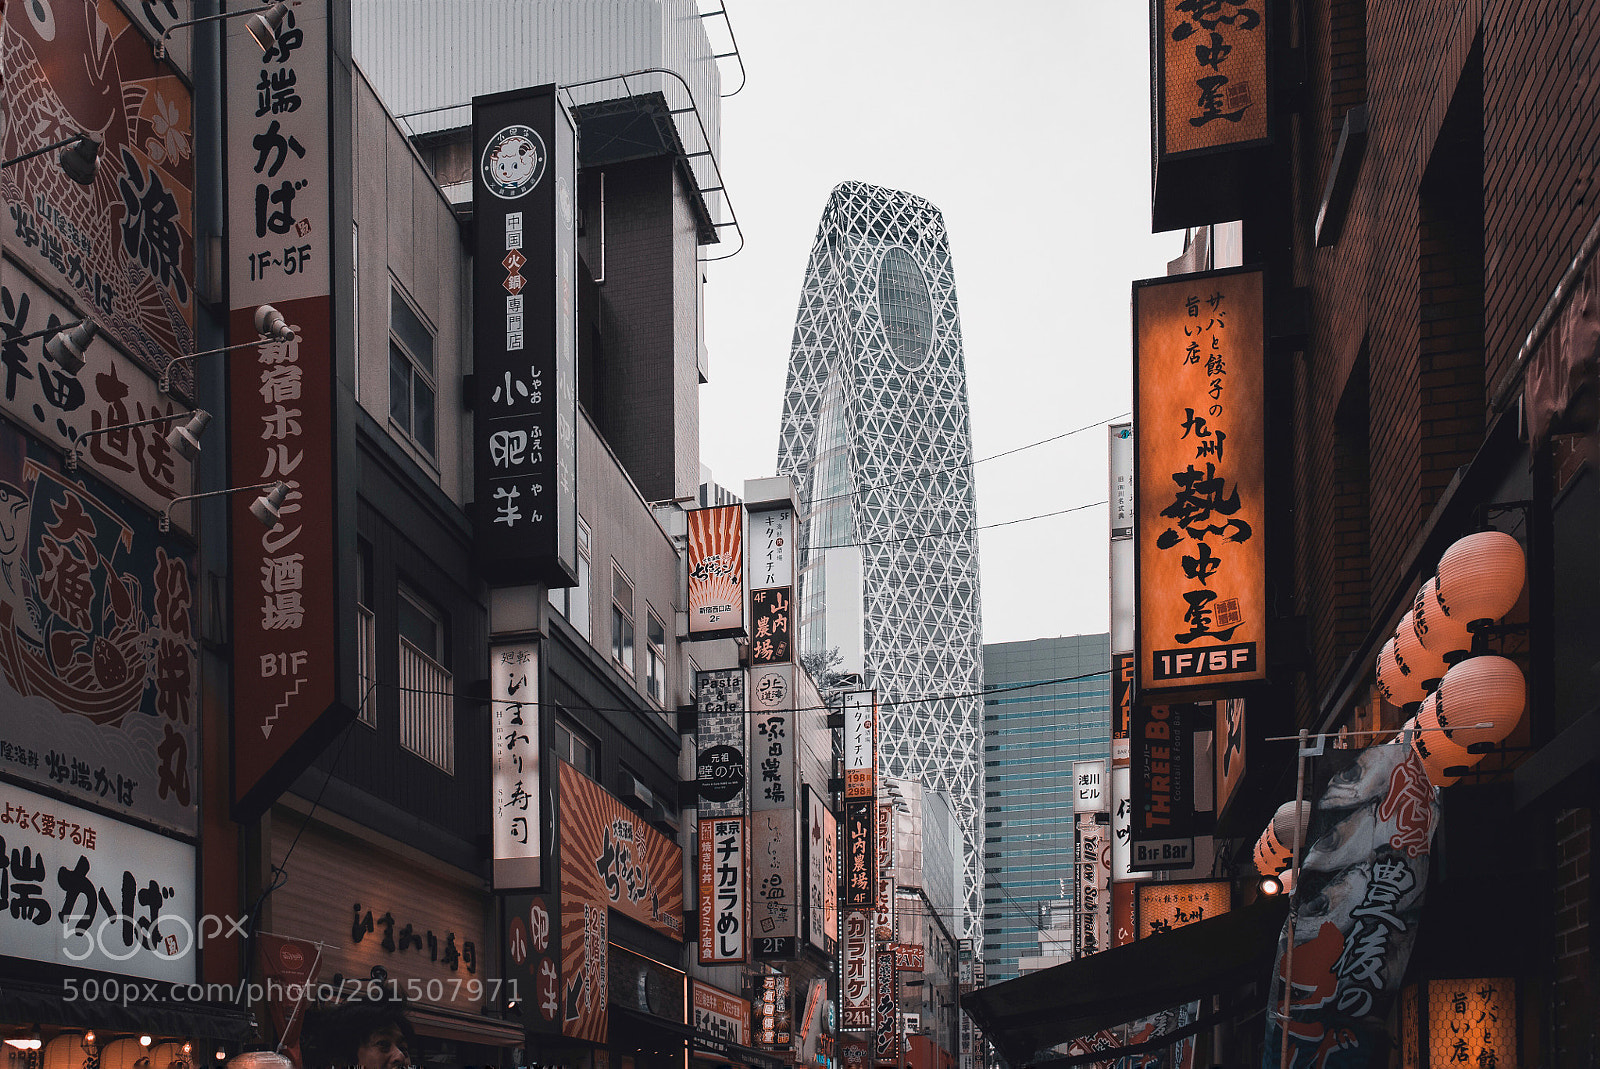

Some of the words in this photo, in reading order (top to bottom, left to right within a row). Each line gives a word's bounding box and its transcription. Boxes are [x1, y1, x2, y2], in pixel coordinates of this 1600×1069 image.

[10, 203, 120, 316] 炉端かば
[507, 213, 523, 350] 中国火鍋専門店
[1183, 295, 1202, 366] 旨い店
[1204, 291, 1227, 418] サバと餃子の
[530, 365, 542, 404] しゃお
[488, 370, 529, 527] 小肥羊
[530, 425, 543, 464] ふぇい
[1180, 407, 1227, 463] 九州
[256, 324, 305, 630] 新宿ホルモン酒場
[530, 483, 543, 522] やん
[780, 512, 790, 521] 5F
[765, 516, 775, 584] キタノイチバ
[1157, 462, 1252, 644] 熱中屋
[754, 592, 767, 602] 4F
[771, 592, 788, 633] 山内
[709, 615, 720, 623] 2F
[753, 616, 775, 661] 農場
[259, 650, 308, 678] B1F
[1161, 649, 1249, 675] 1F/5F
[701, 678, 741, 690] Pasta
[705, 702, 737, 713] Cafe
[1173, 711, 1182, 726] Bar
[853, 700, 863, 767] キタノイチバ
[1173, 729, 1182, 751] Food
[504, 673, 532, 845] ひまわり寿司
[698, 763, 744, 780] 壁の穴
[711, 752, 730, 763] 元祖
[45, 752, 138, 806] 炉端かば
[1078, 773, 1100, 786] 浅川
[1079, 788, 1100, 800] ビル
[1145, 746, 1171, 829] THREE
[1173, 765, 1182, 801] Cocktail
[715, 821, 740, 836] 東京
[851, 821, 869, 890] 山内農場
[1084, 835, 1098, 882] Yellow
[1163, 843, 1187, 860] Bar
[717, 836, 739, 957] チカラめし
[853, 893, 866, 903] 4F
[763, 937, 786, 953] 2F
[847, 917, 867, 1000] カラオケ
[844, 1011, 870, 1026] 24h
[1450, 991, 1471, 1063] 旨い店
